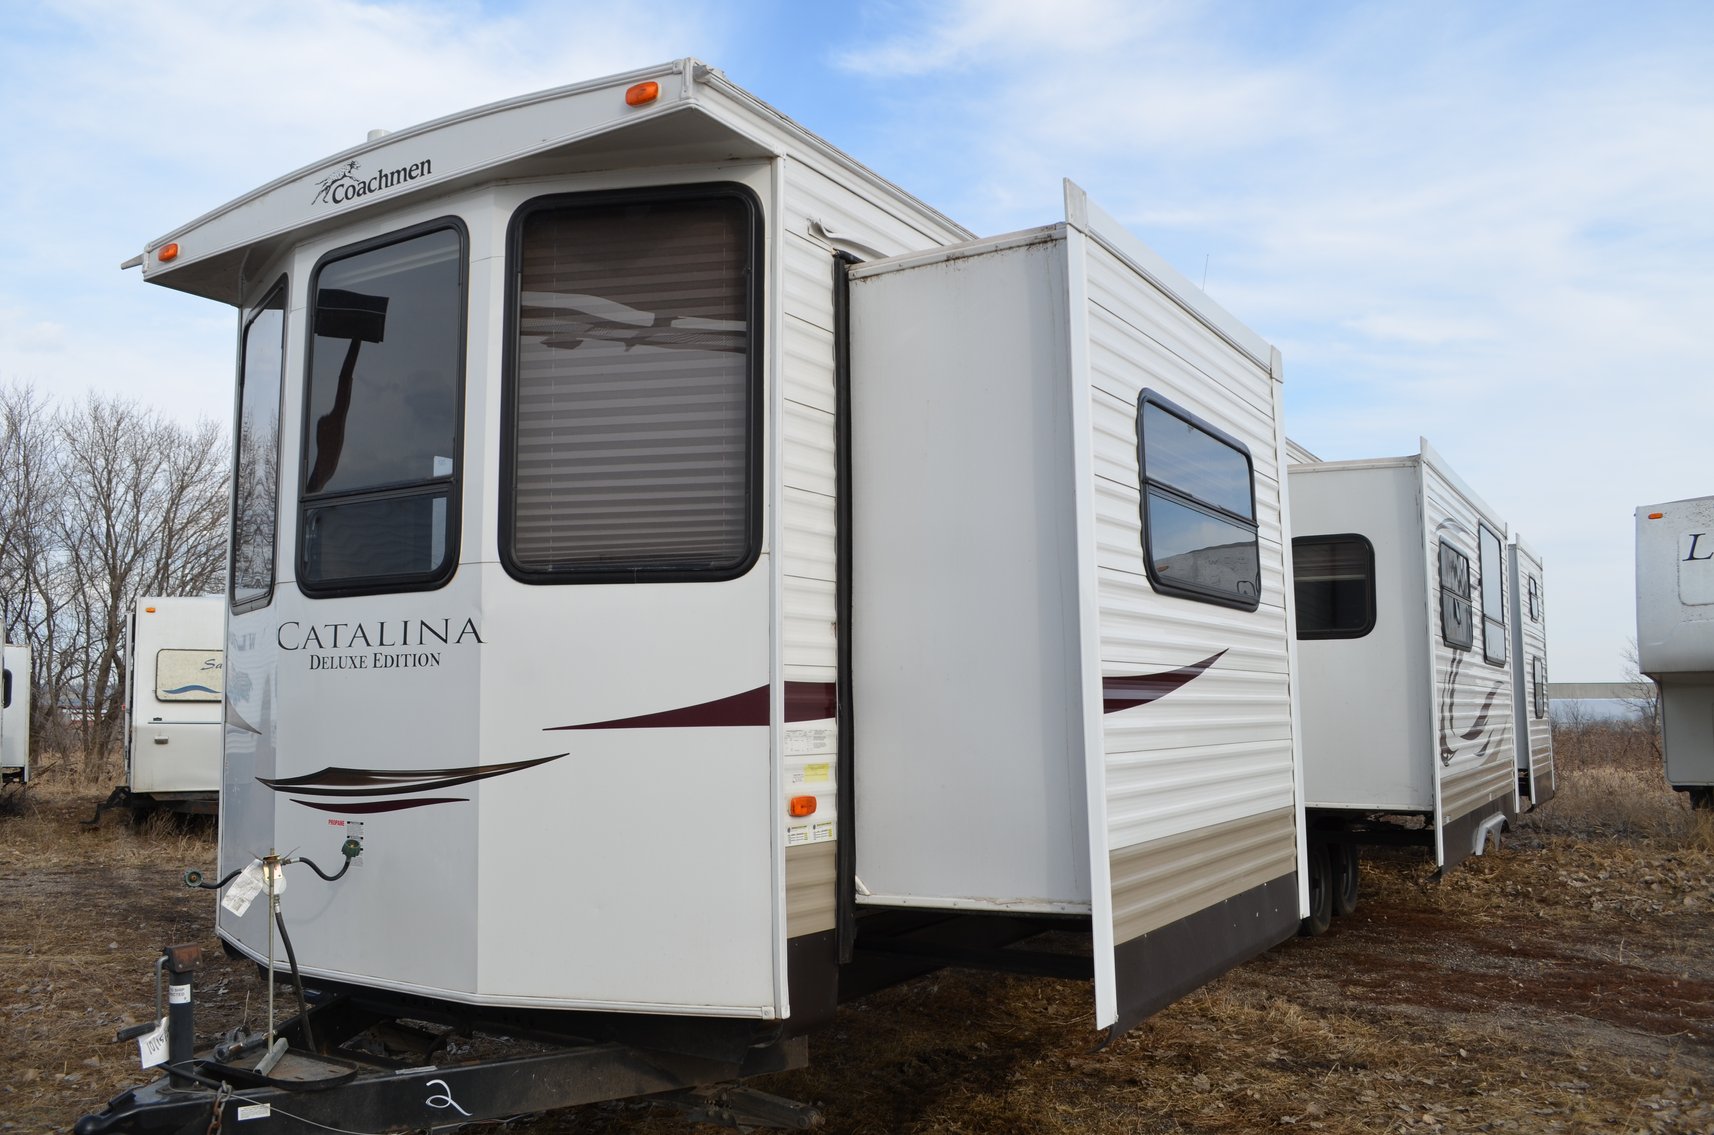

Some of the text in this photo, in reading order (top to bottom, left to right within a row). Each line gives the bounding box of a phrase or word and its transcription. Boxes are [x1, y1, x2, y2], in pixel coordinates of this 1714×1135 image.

[332, 159, 432, 204] Coachmen
[277, 617, 488, 651] CATALINA
[309, 652, 441, 670] DELUXE EDITION
[328, 819, 345, 827] PROPANE
[425, 1079, 473, 1116] 2
